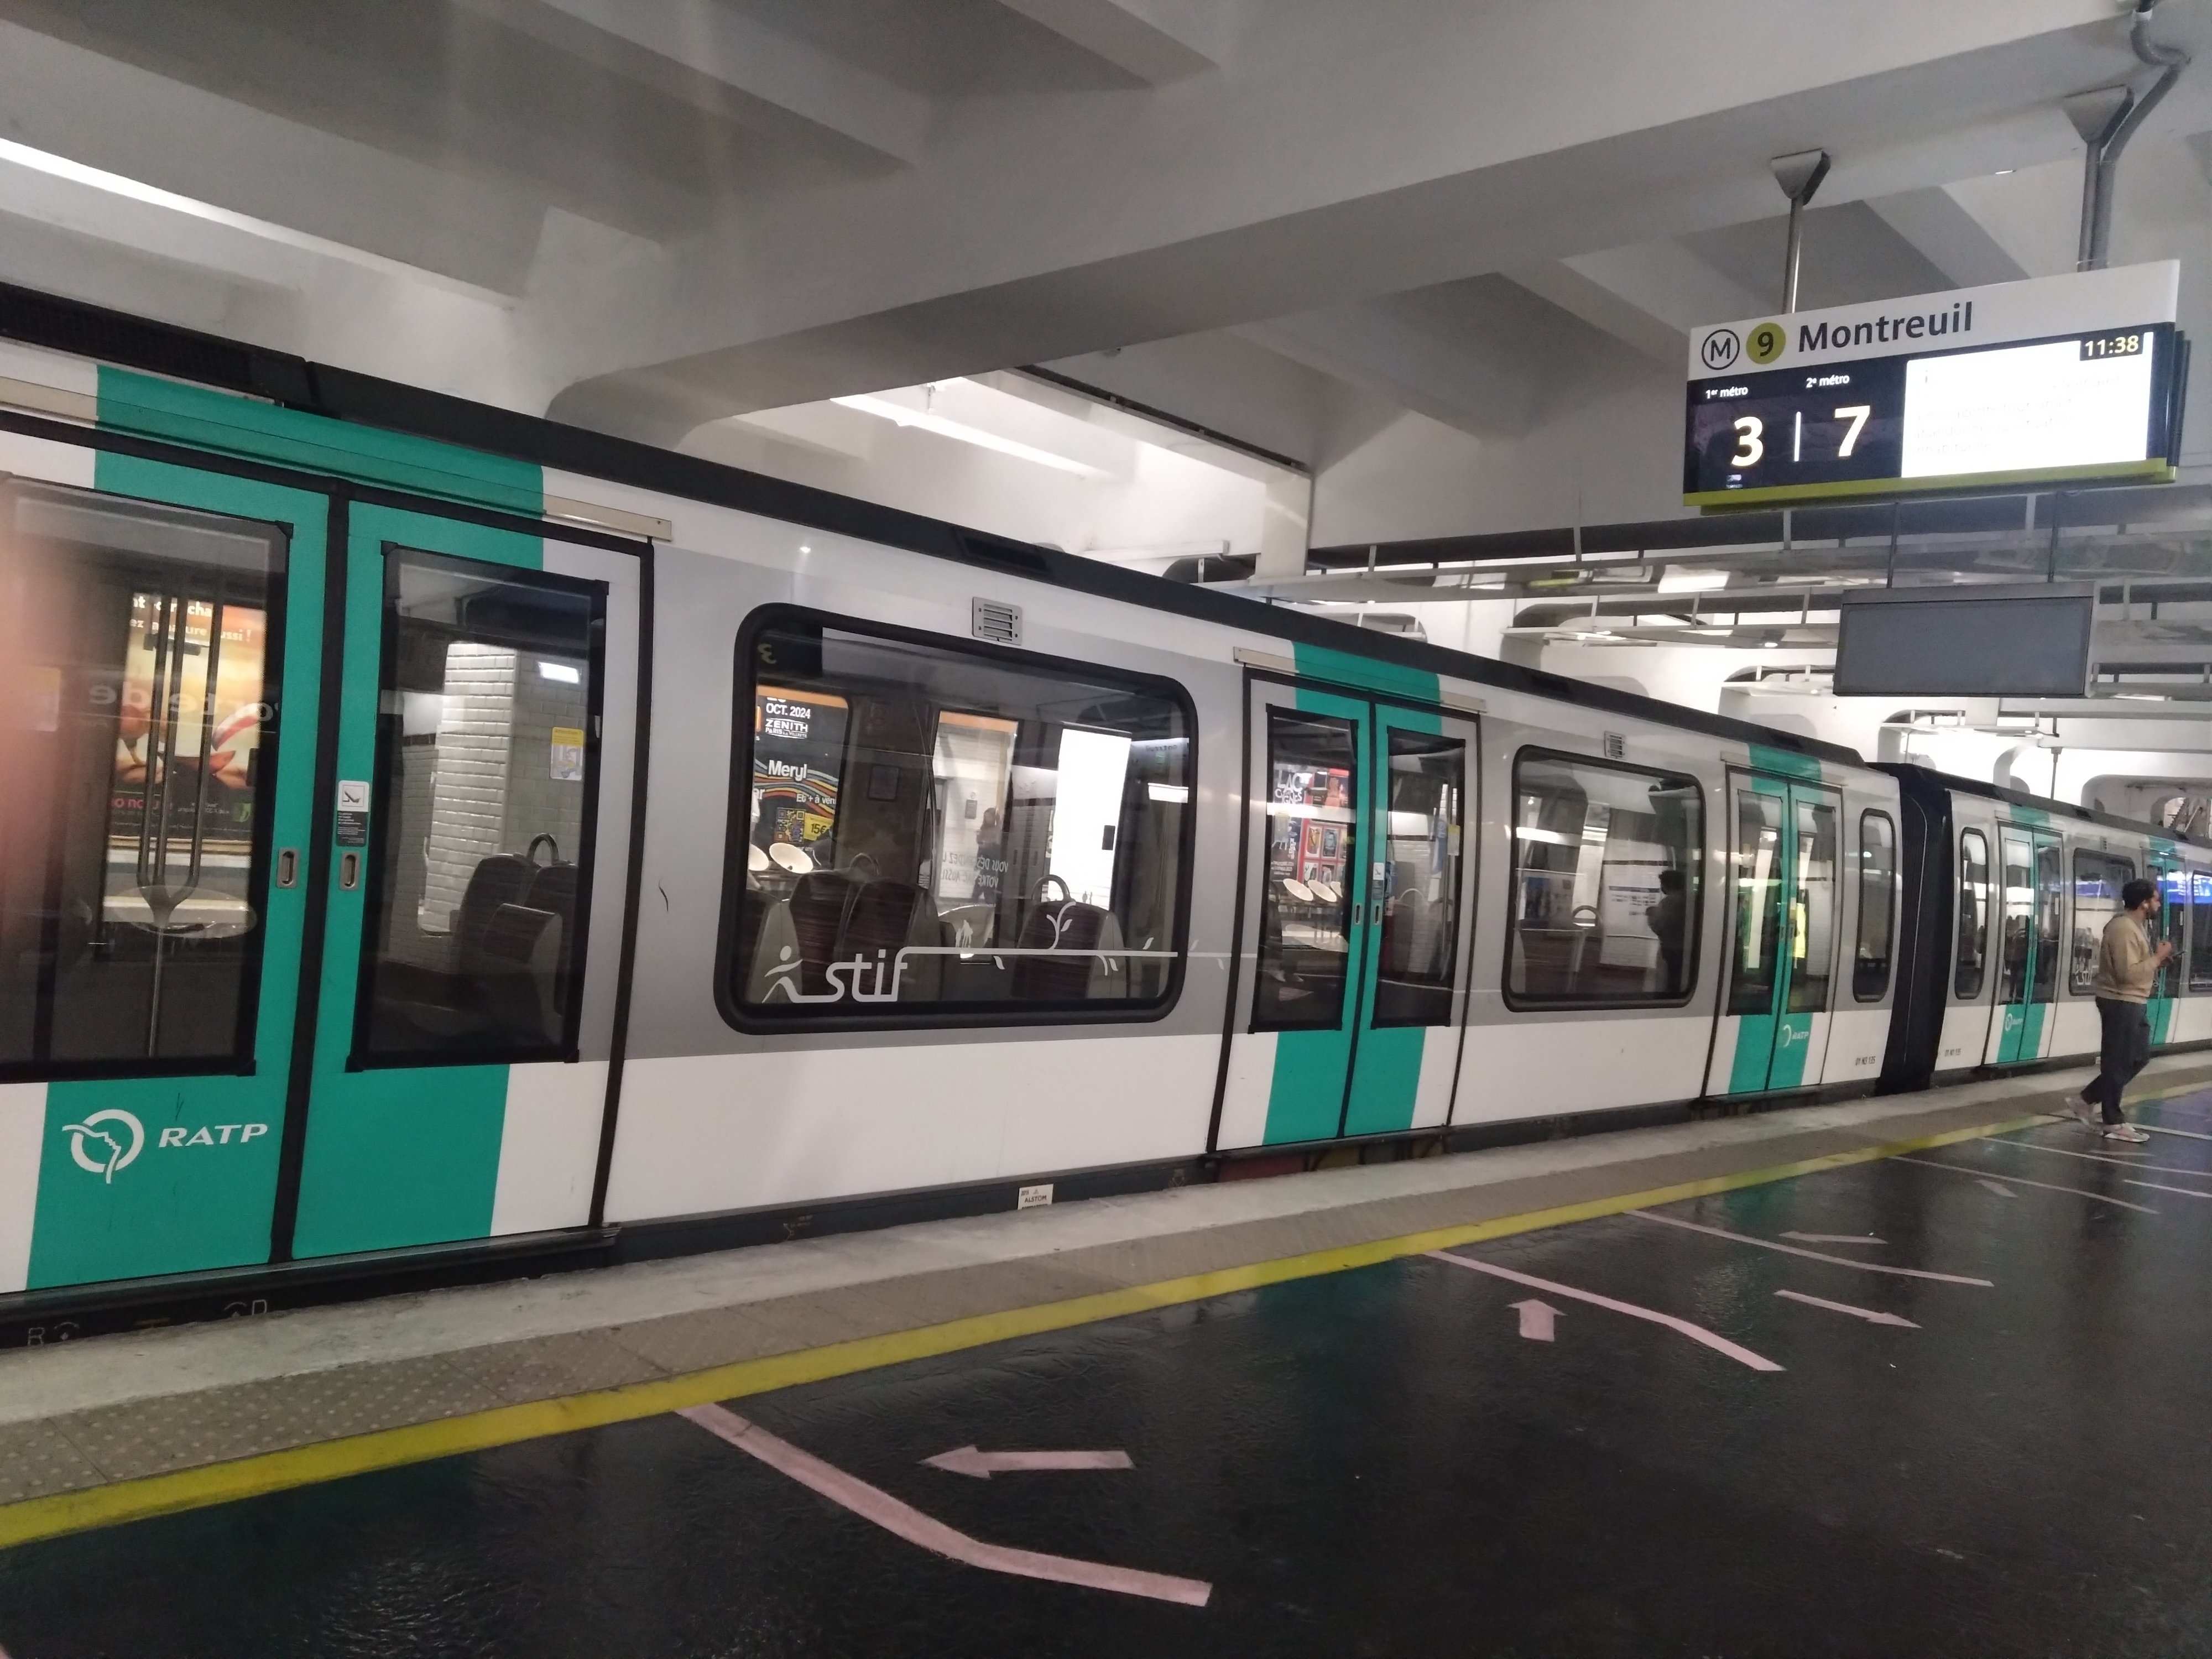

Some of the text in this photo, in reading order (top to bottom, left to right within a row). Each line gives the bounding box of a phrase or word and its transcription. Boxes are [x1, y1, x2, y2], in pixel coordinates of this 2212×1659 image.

[1757, 331, 1774, 357] 9
[1799, 301, 1972, 352] Montreuil
[2085, 335, 2138, 356] 11:38
[1819, 374, 1850, 386] métro
[1720, 387, 1748, 397] métro
[1731, 416, 1763, 466] 3
[1835, 405, 1870, 457] 7
[766, 703, 811, 719] OCT. 2024
[765, 718, 808, 732] ZENITH
[768, 759, 807, 781] Meryl
[1277, 769, 1303, 792] LAC
[811, 823, 827, 834] 15€
[159, 1123, 268, 1147] RATP
[1024, 1195, 1047, 1203] ALSTOM
